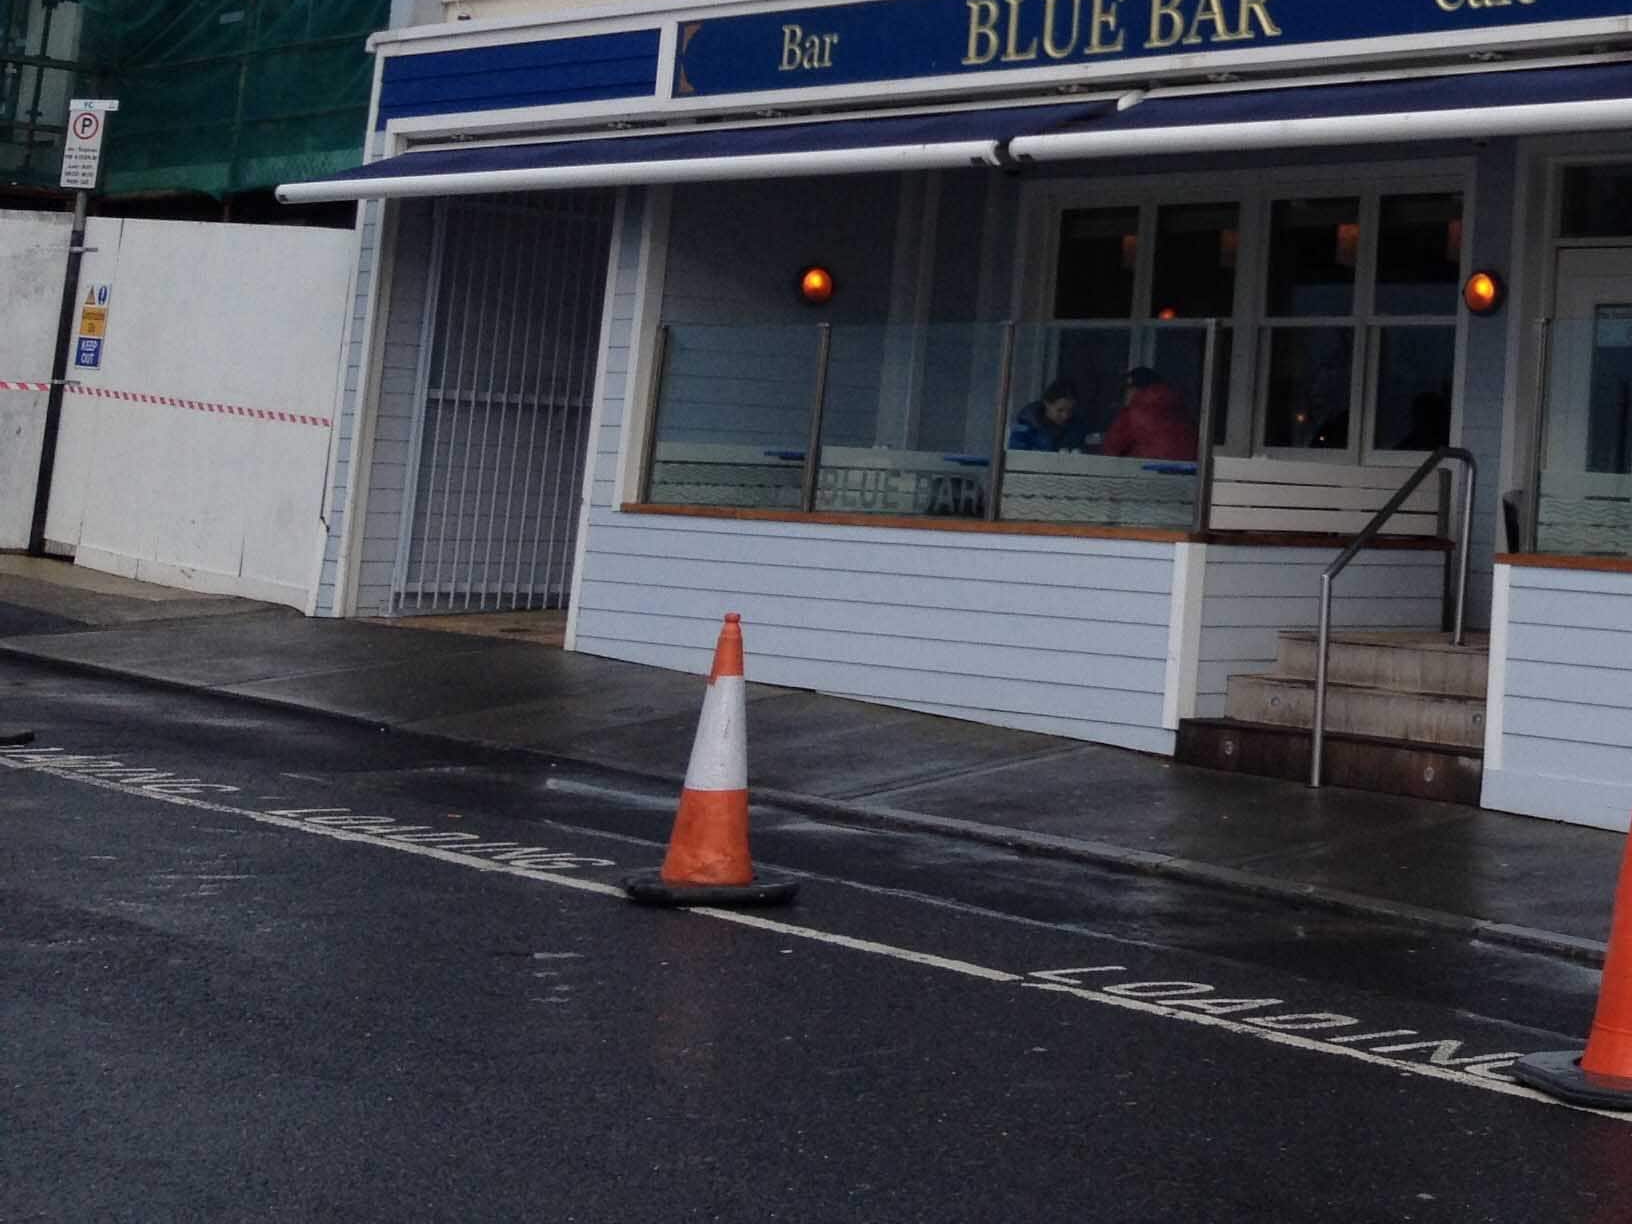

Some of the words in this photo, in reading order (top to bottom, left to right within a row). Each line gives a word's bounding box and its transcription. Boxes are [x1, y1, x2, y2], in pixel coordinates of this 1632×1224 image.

[778, 23, 838, 72] Bar
[817, 468, 896, 511] BLUE
[264, 807, 617, 870] LOADING
